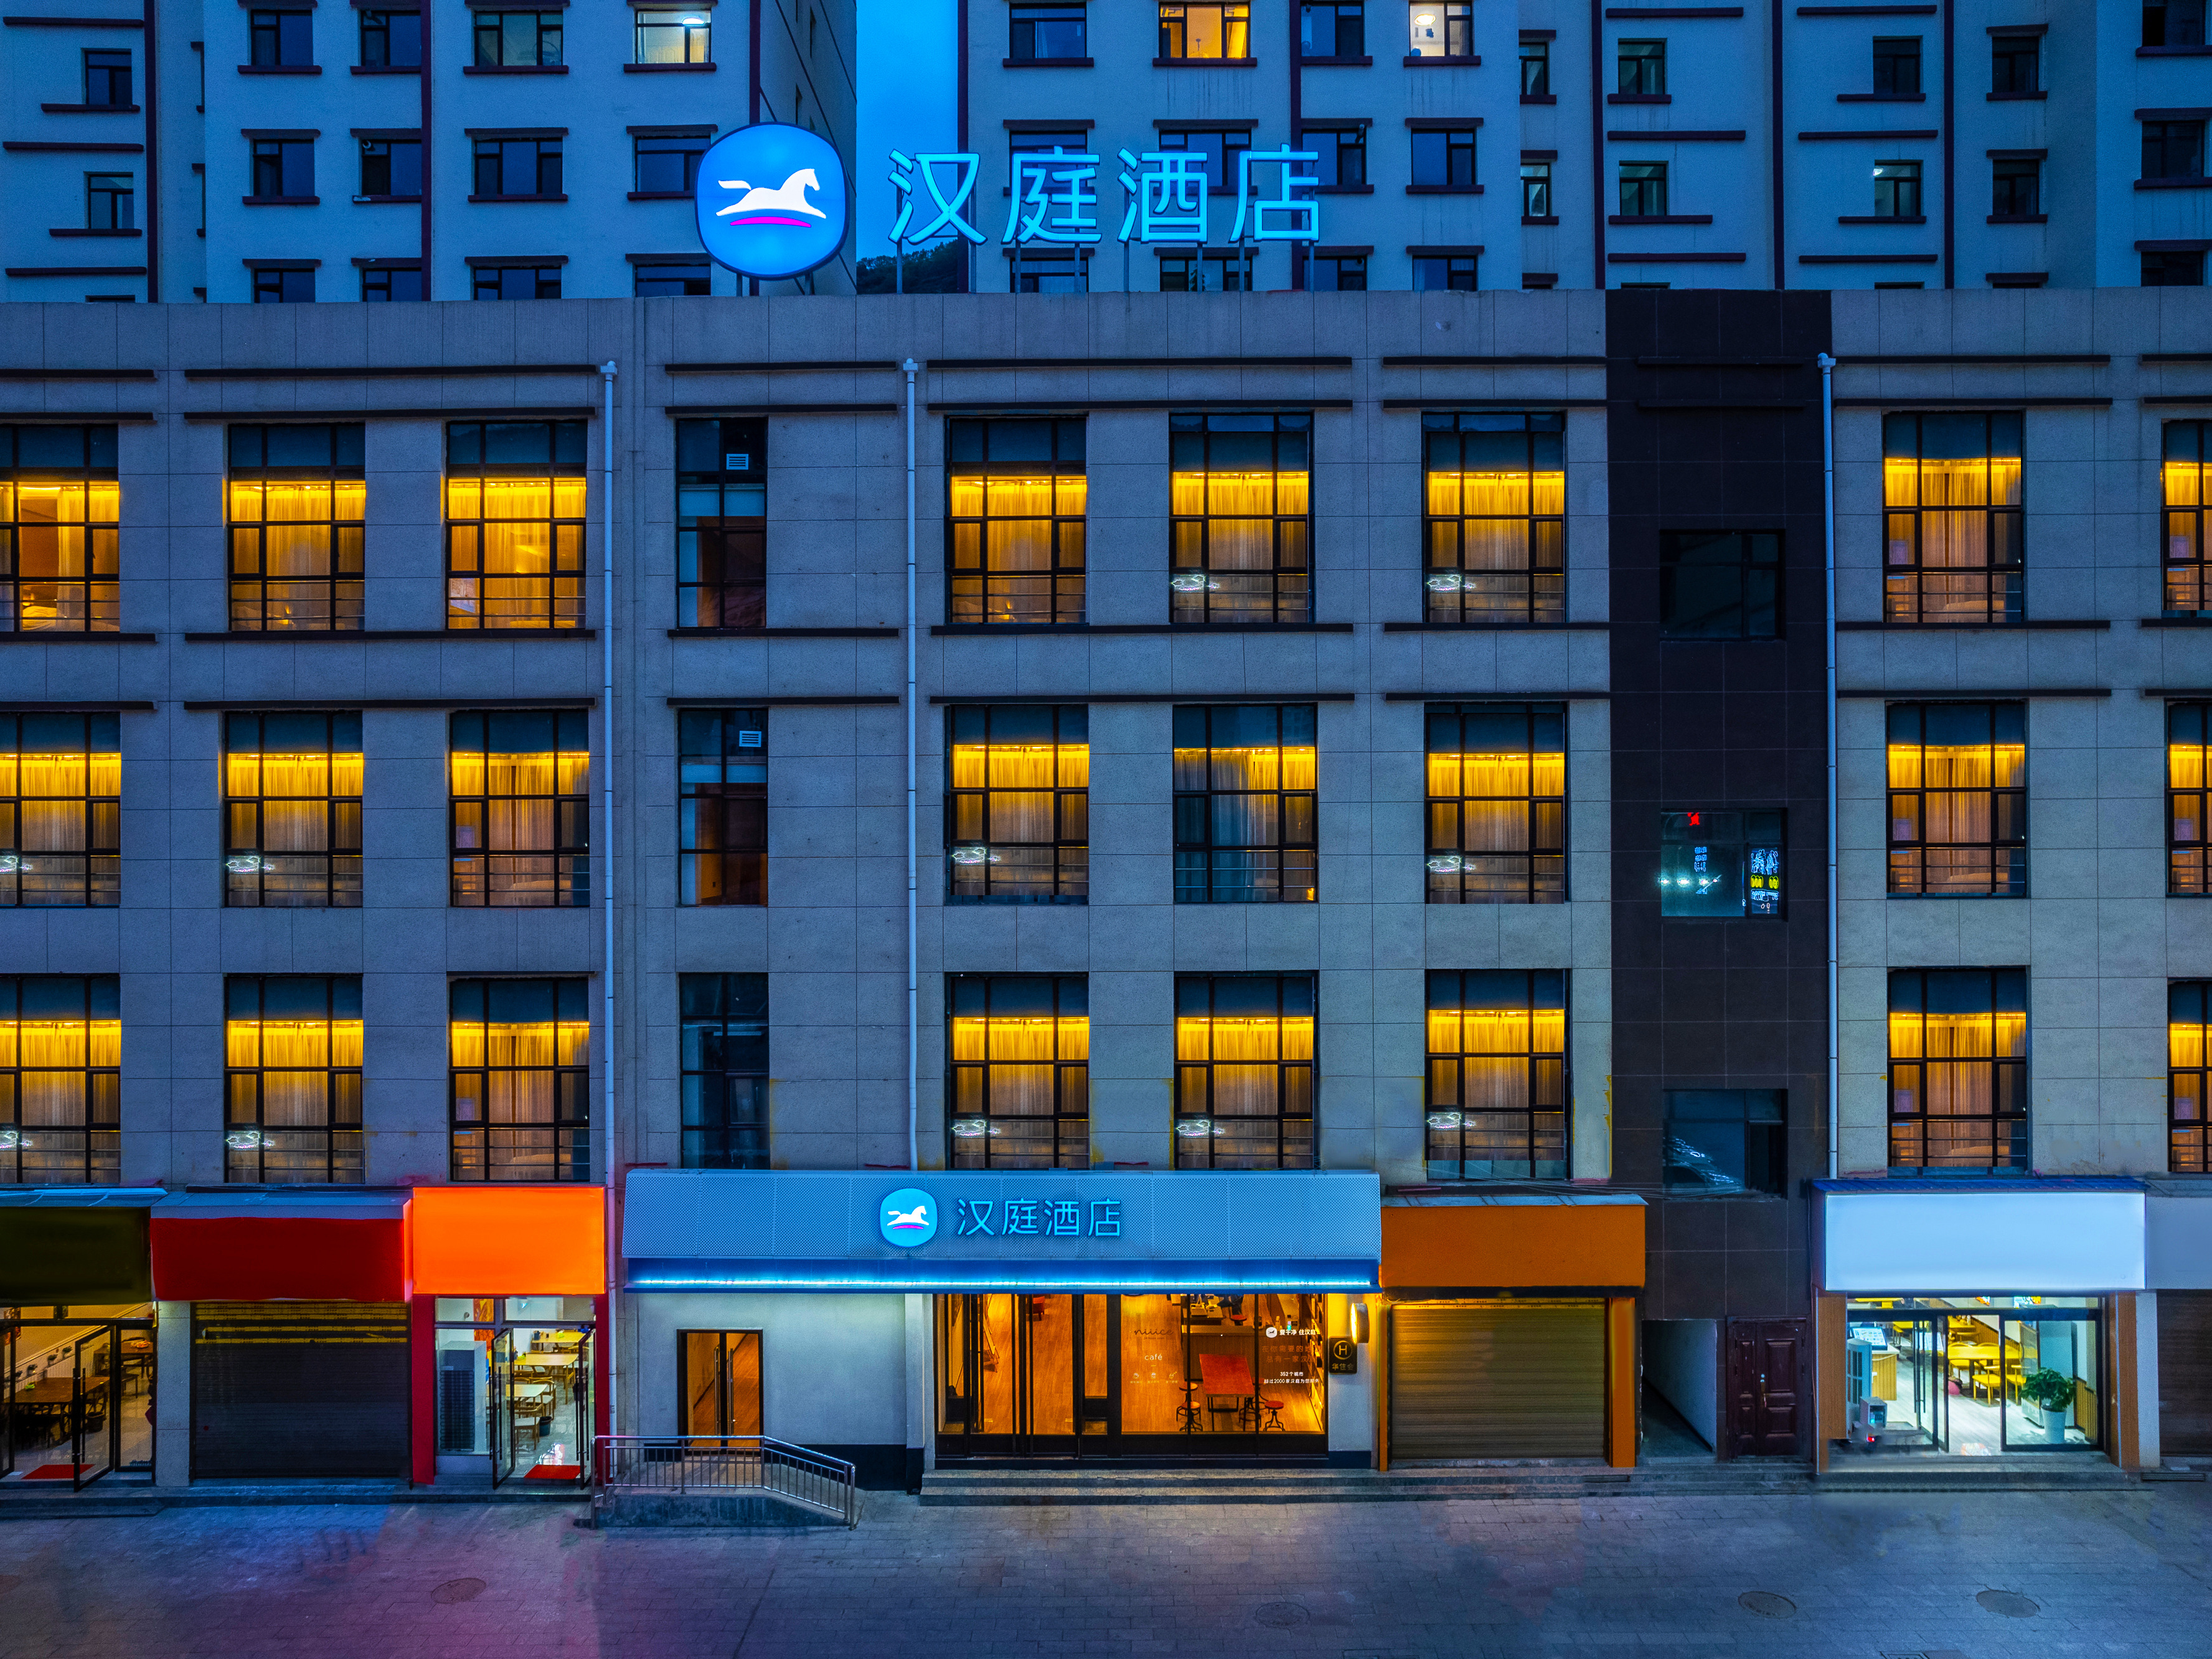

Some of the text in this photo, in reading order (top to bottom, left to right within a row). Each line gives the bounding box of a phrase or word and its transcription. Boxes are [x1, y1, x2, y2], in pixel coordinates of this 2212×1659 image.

[888, 144, 1319, 244] 汉庭酒店
[957, 1198, 1121, 1236] 汉庭酒店
[1339, 1345, 1347, 1355] H
[1332, 1363, 1354, 1371] 华住会
